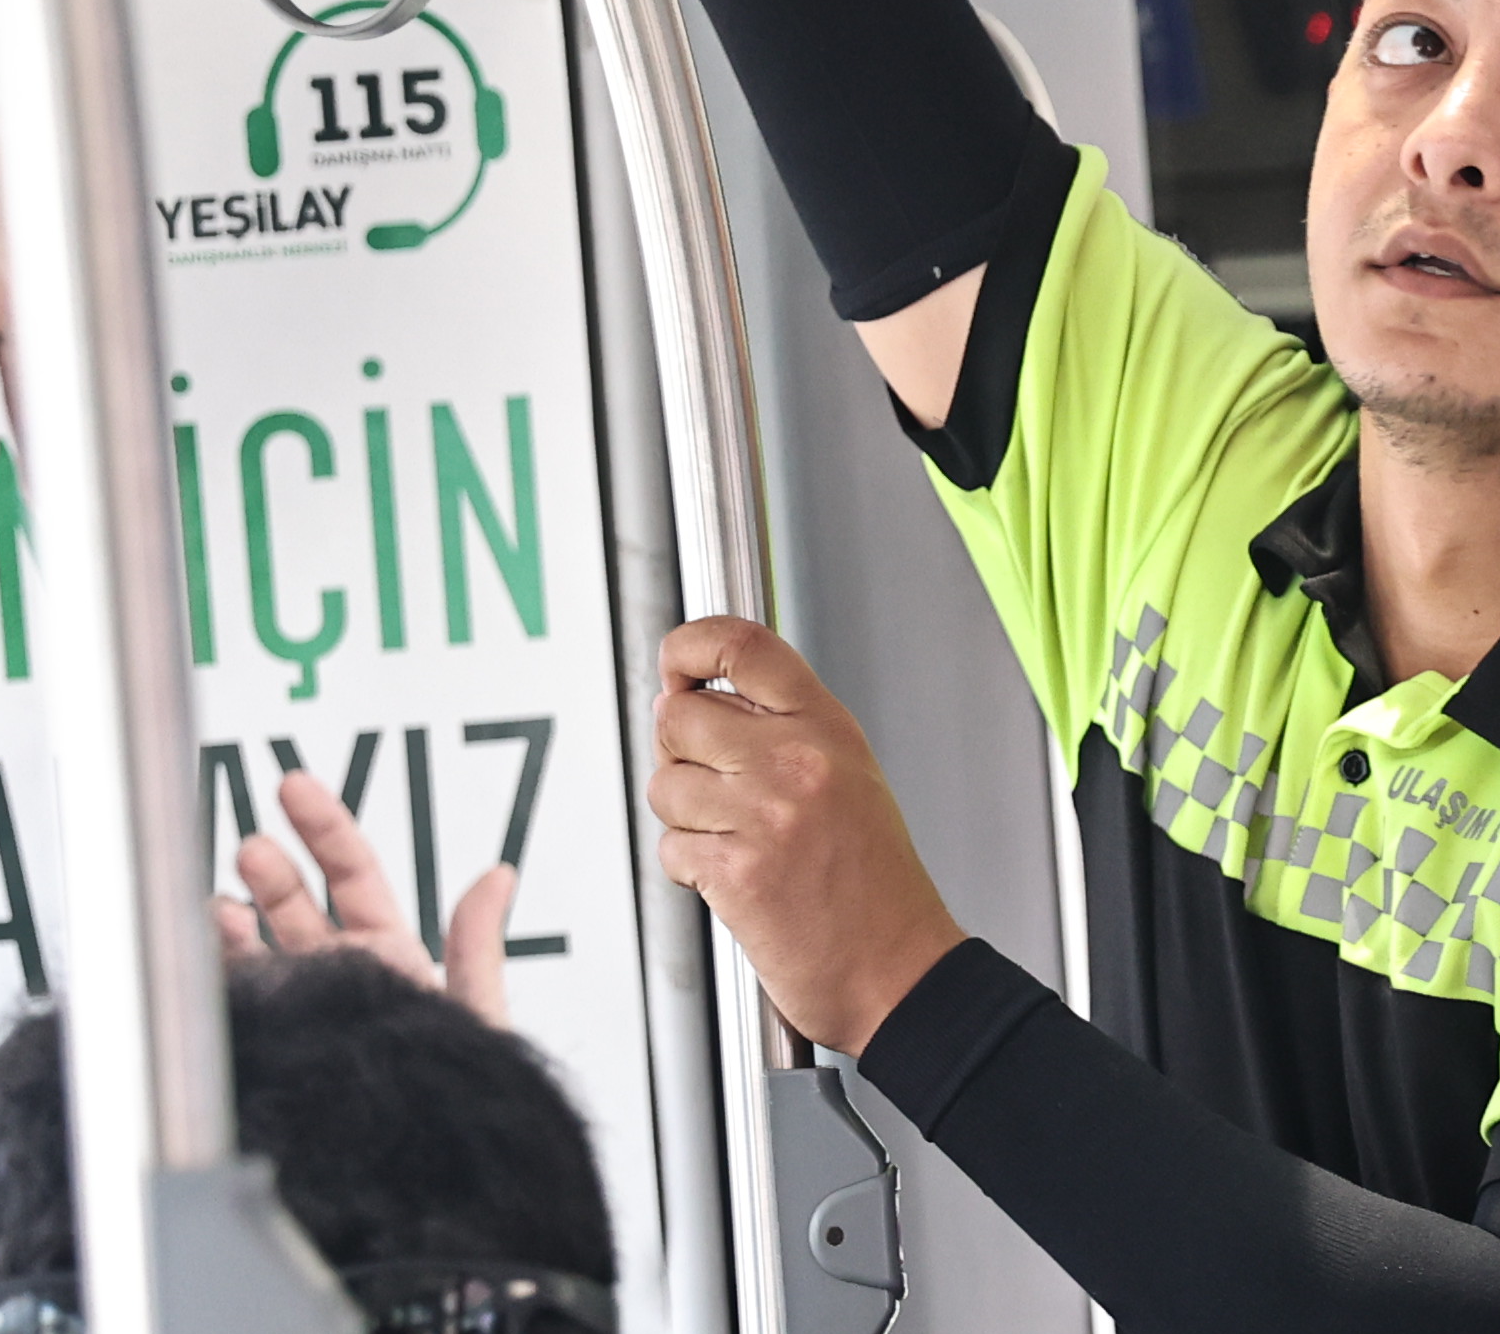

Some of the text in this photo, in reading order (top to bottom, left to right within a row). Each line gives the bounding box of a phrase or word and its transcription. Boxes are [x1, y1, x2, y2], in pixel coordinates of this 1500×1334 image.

[310, 69, 447, 142] 115
[155, 182, 353, 239] YEŞİLAY
[170, 358, 550, 701] İÇİN
